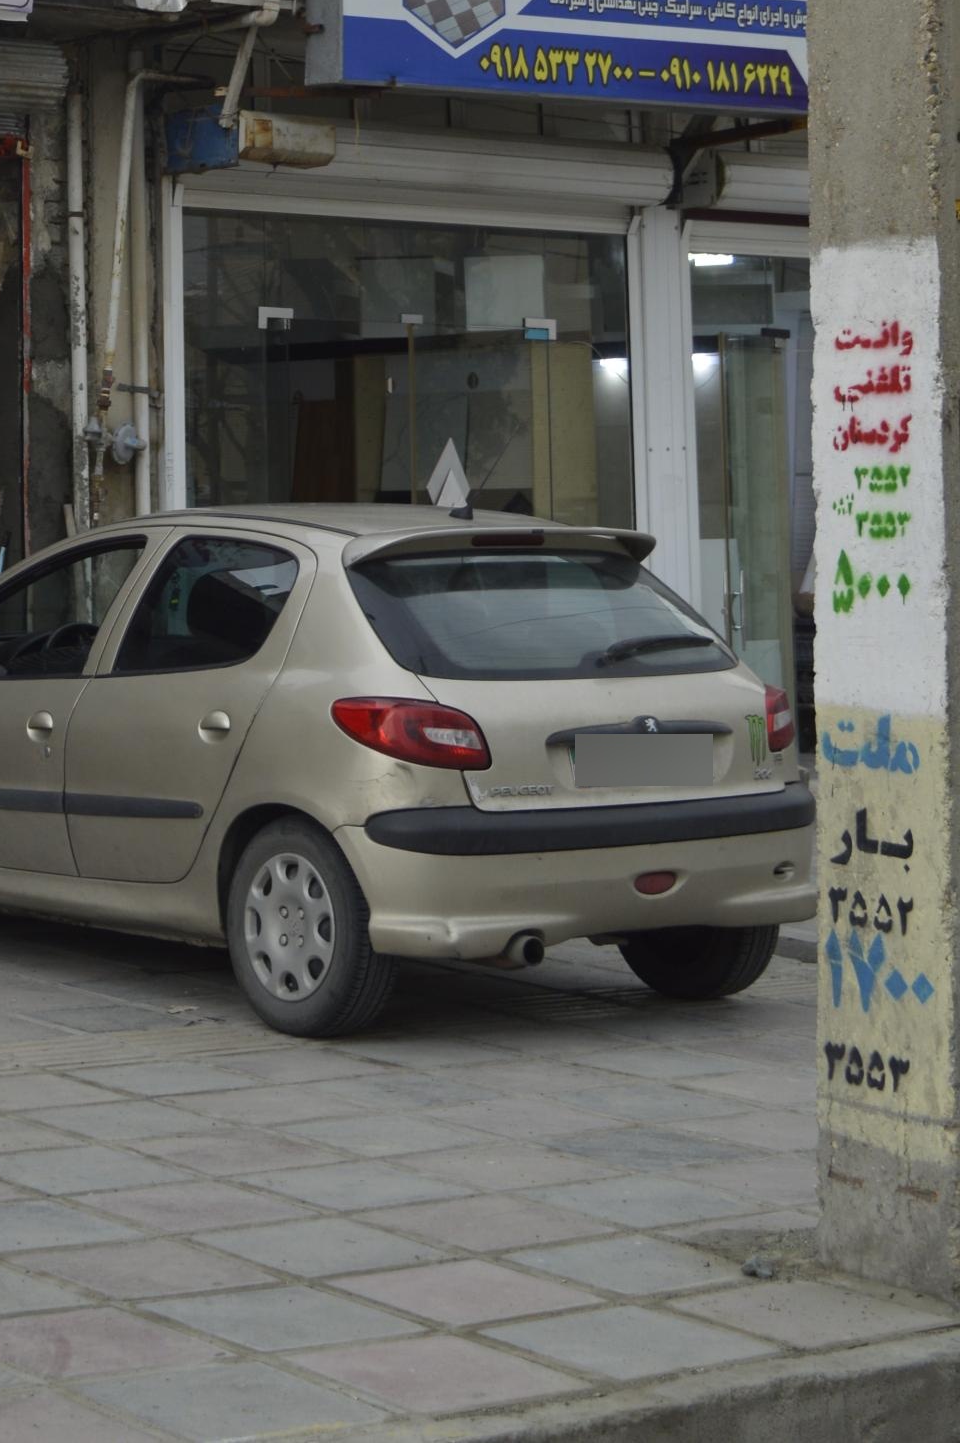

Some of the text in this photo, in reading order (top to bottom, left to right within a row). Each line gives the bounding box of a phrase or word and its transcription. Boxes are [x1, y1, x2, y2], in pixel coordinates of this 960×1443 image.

[708, 1, 736, 22] کاشی
[737, 3, 758, 27] انواع
[759, 5, 782, 27] اجرای
[480, 43, 529, 80] ۰۹۱۸
[534, 46, 580, 83] ۵۳۳
[584, 49, 634, 85] ۲۷۰۰
[660, 56, 702, 91] ۰۹۱۰
[706, 59, 739, 93] ۱۸۱
[743, 62, 793, 97] ۶۲۲۹
[822, 713, 921, 774] ملت
[489, 784, 555, 797] PEUGEOT
[830, 807, 914, 873] بار
[829, 886, 914, 936] ۳۵۵۲
[824, 1040, 910, 1092] ۳۵۵۳
